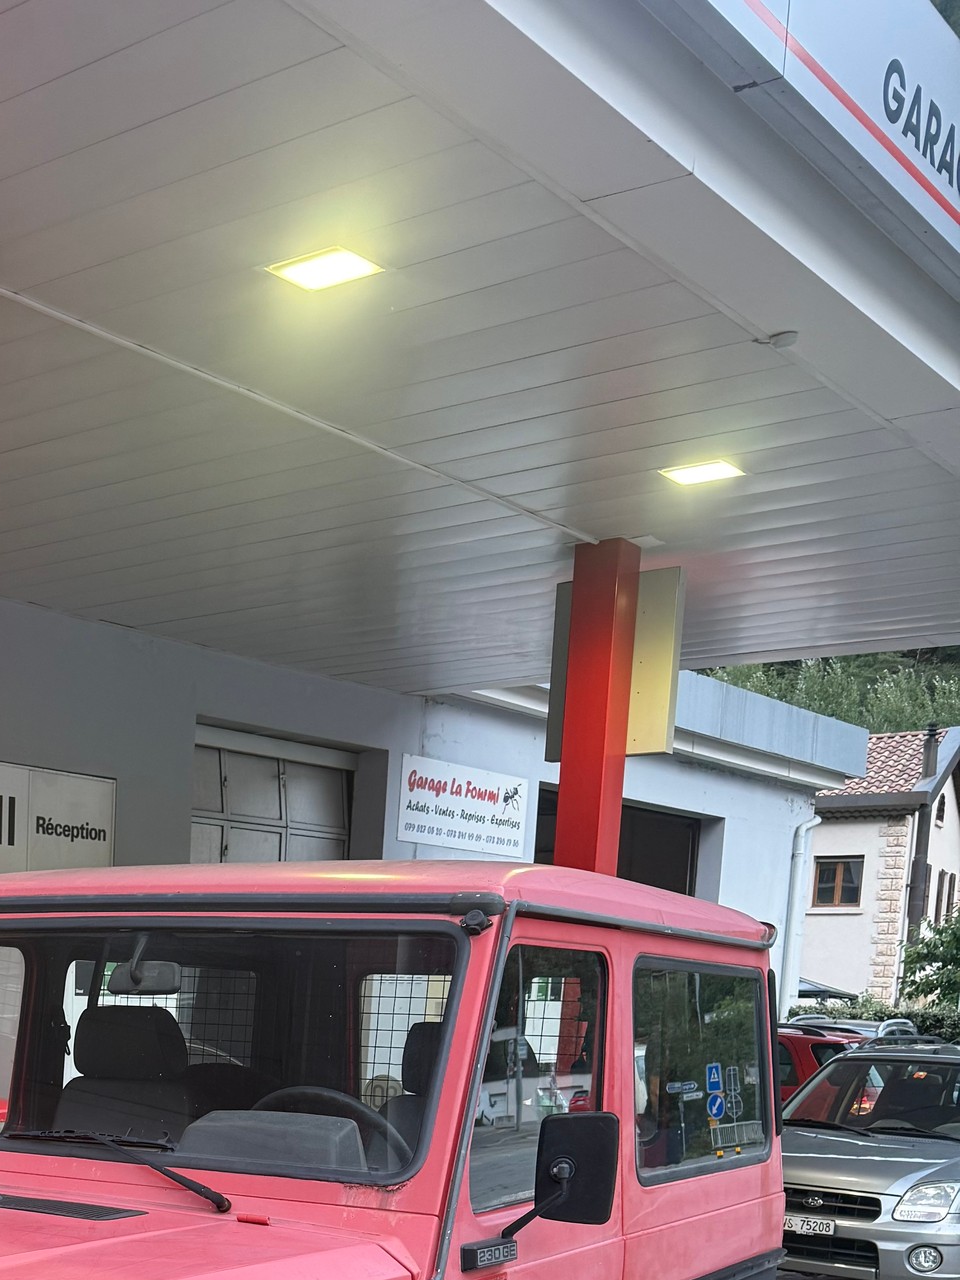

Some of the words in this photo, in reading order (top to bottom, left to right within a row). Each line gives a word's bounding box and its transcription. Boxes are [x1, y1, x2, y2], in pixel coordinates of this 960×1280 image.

[883, 58, 960, 197] GARA
[408, 769, 448, 798] Garage
[450, 778, 462, 797] La
[464, 780, 500, 805] Fourmi
[35, 815, 107, 842] Réception
[406, 799, 430, 815] Achats
[434, 804, 455, 819] Ventes
[460, 809, 486, 824] Reprises
[490, 814, 521, 830] Expertises
[800, 1219, 831, 1233] 75208
[479, 1247, 501, 1264] 230
[502, 1243, 517, 1258] GE
